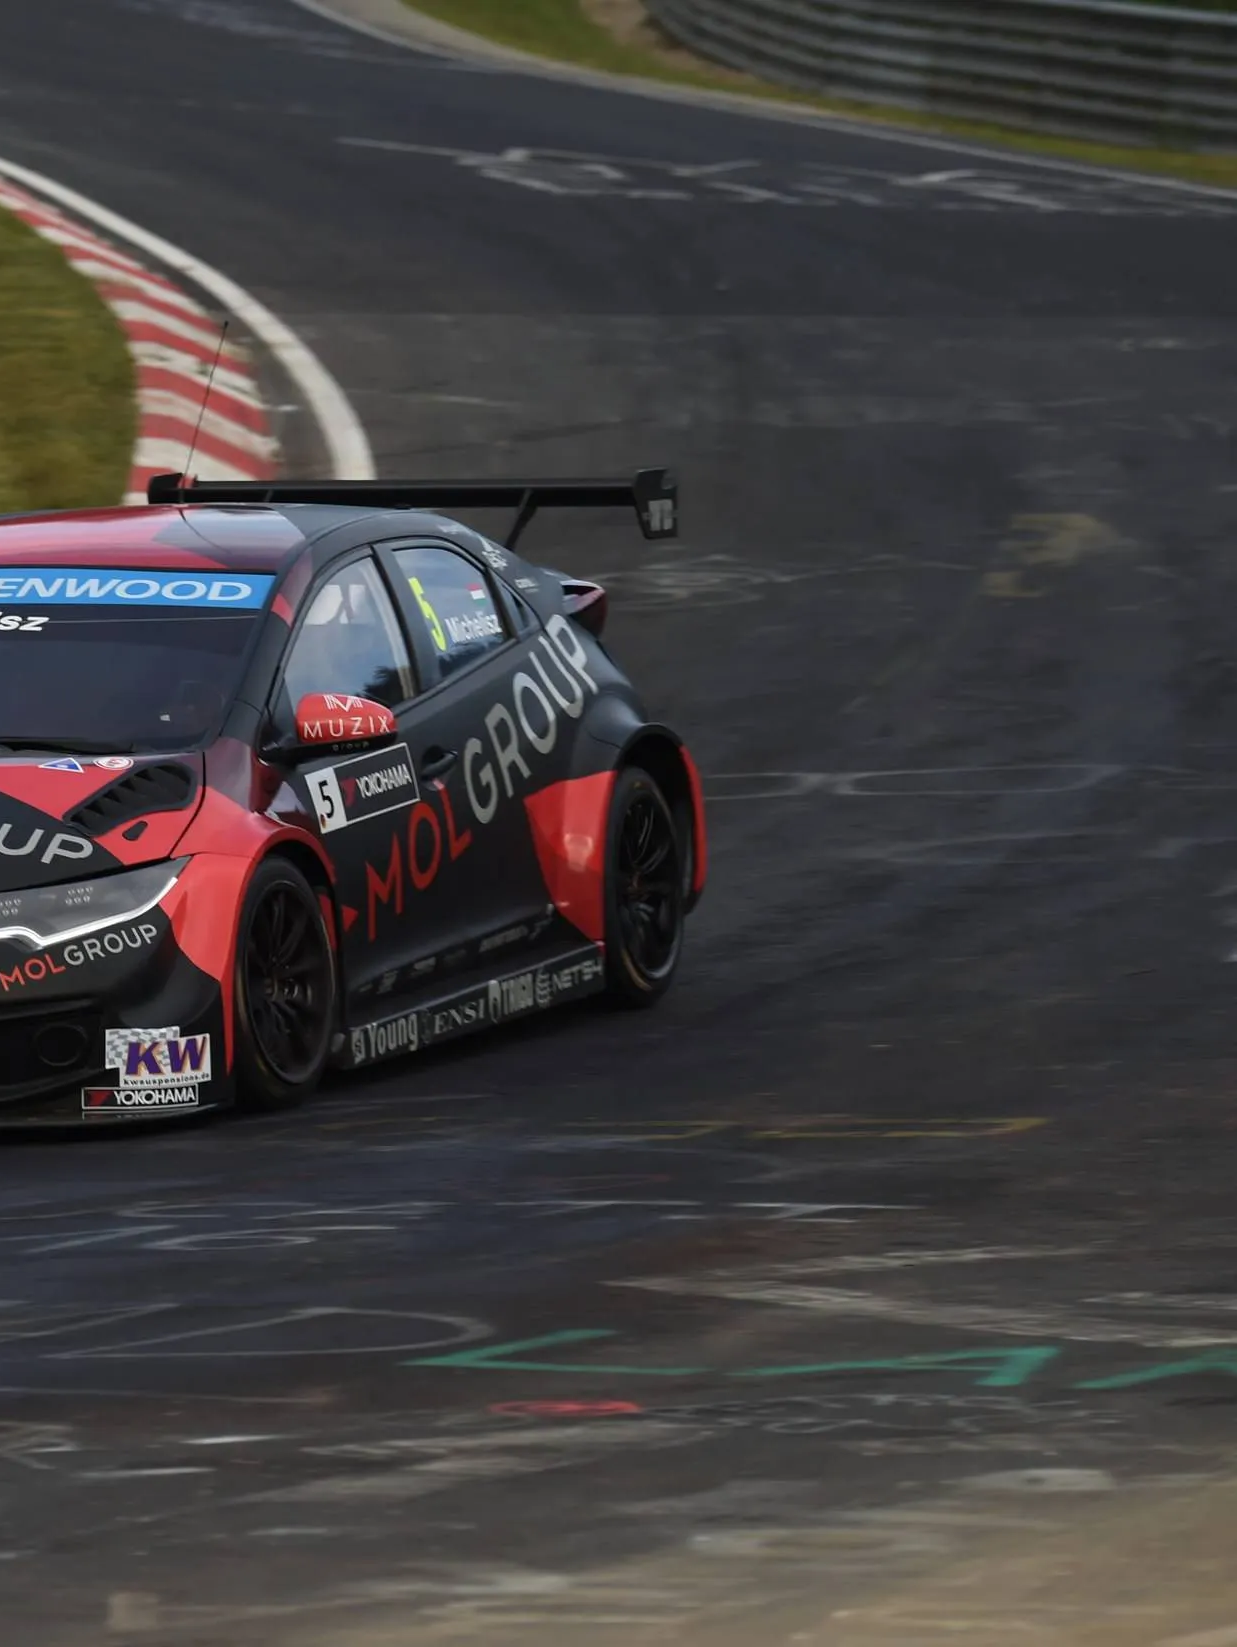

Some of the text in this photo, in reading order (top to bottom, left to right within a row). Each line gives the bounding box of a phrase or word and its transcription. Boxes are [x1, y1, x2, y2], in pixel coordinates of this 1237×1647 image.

[408, 577, 446, 651] 5
[444, 612, 503, 644] Michelisz
[304, 716, 390, 739] MUZIX
[318, 764, 412, 818] 5 YOKOHAMA
[365, 614, 598, 942] MOLGROUP
[125, 1036, 206, 1075] KW
[114, 1087, 196, 1105] YOKOHAMA
